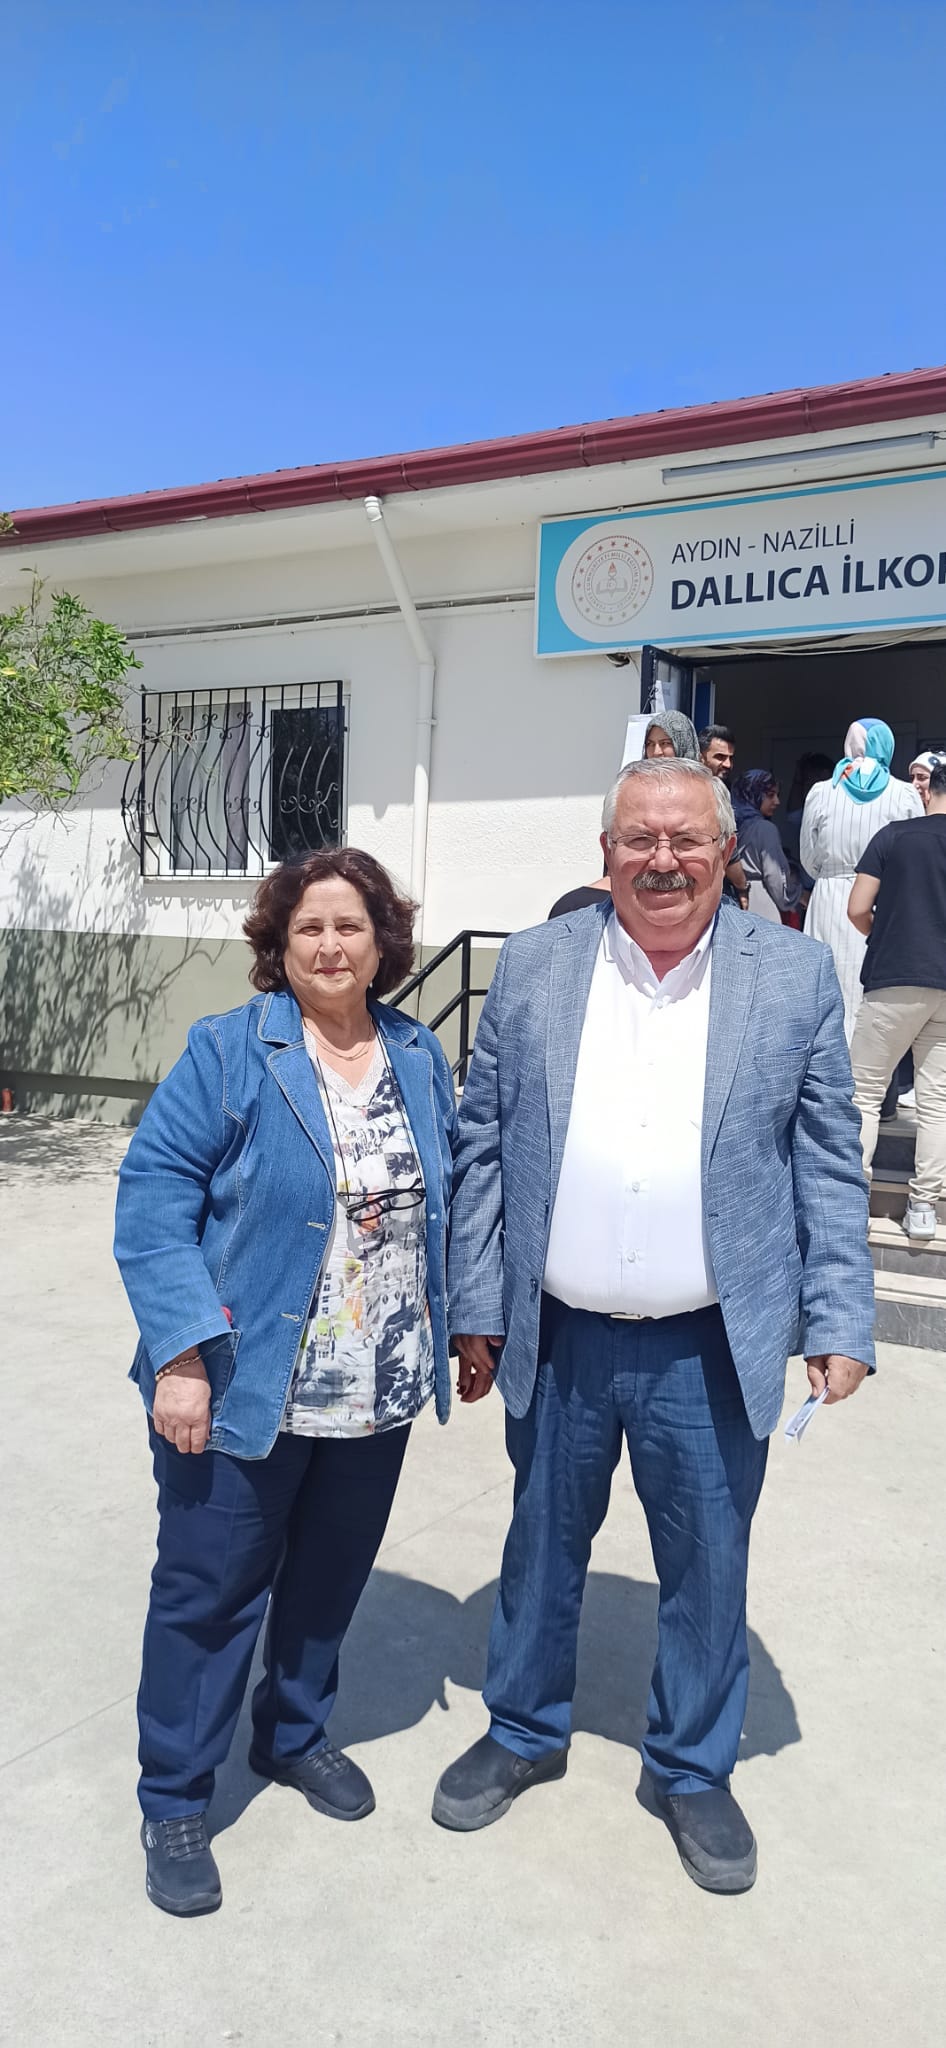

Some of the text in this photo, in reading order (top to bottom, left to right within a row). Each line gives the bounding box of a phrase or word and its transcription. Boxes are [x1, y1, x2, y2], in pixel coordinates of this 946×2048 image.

[671, 536, 741, 565] AYDIN
[763, 518, 854, 554] NAZİLLİ
[671, 565, 830, 610] DALLICA
